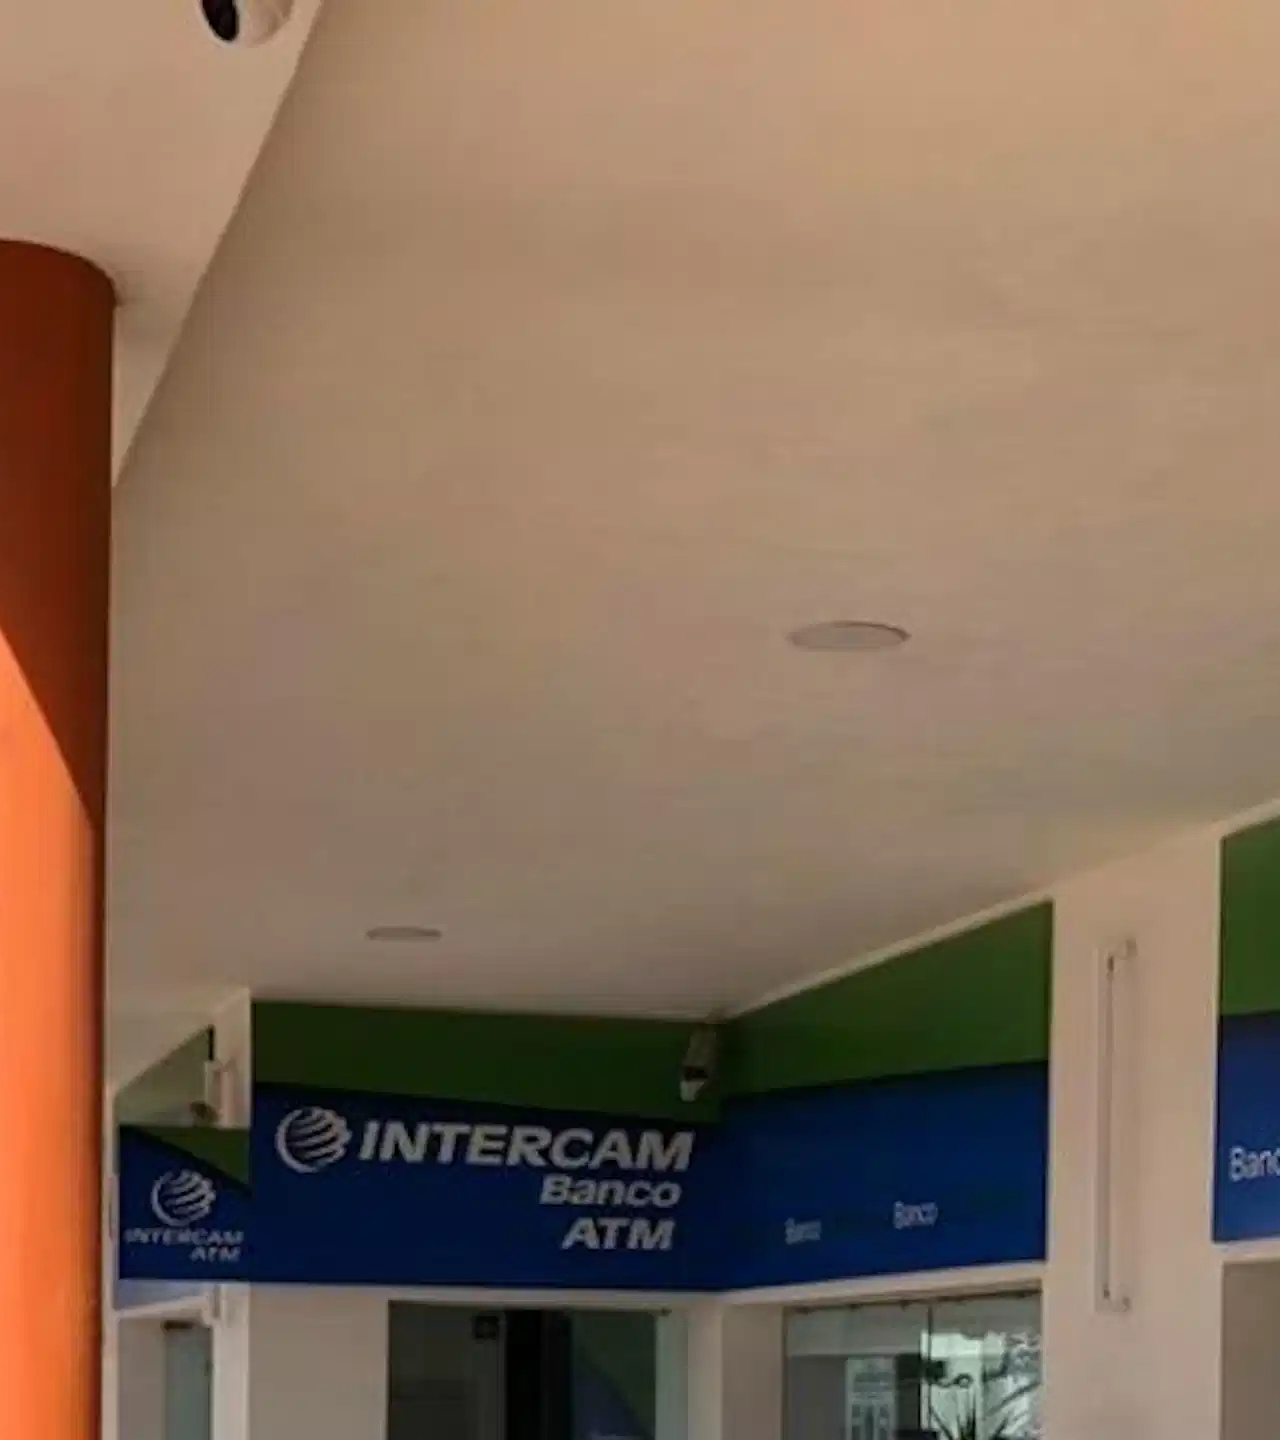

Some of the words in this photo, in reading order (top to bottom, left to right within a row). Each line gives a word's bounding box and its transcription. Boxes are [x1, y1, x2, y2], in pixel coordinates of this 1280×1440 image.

[357, 1119, 696, 1172] INTERCAM
[538, 1173, 683, 1209] Banco
[123, 1228, 245, 1246] INTERCAM
[560, 1216, 677, 1252] ATM
[188, 1245, 242, 1263] ATM
